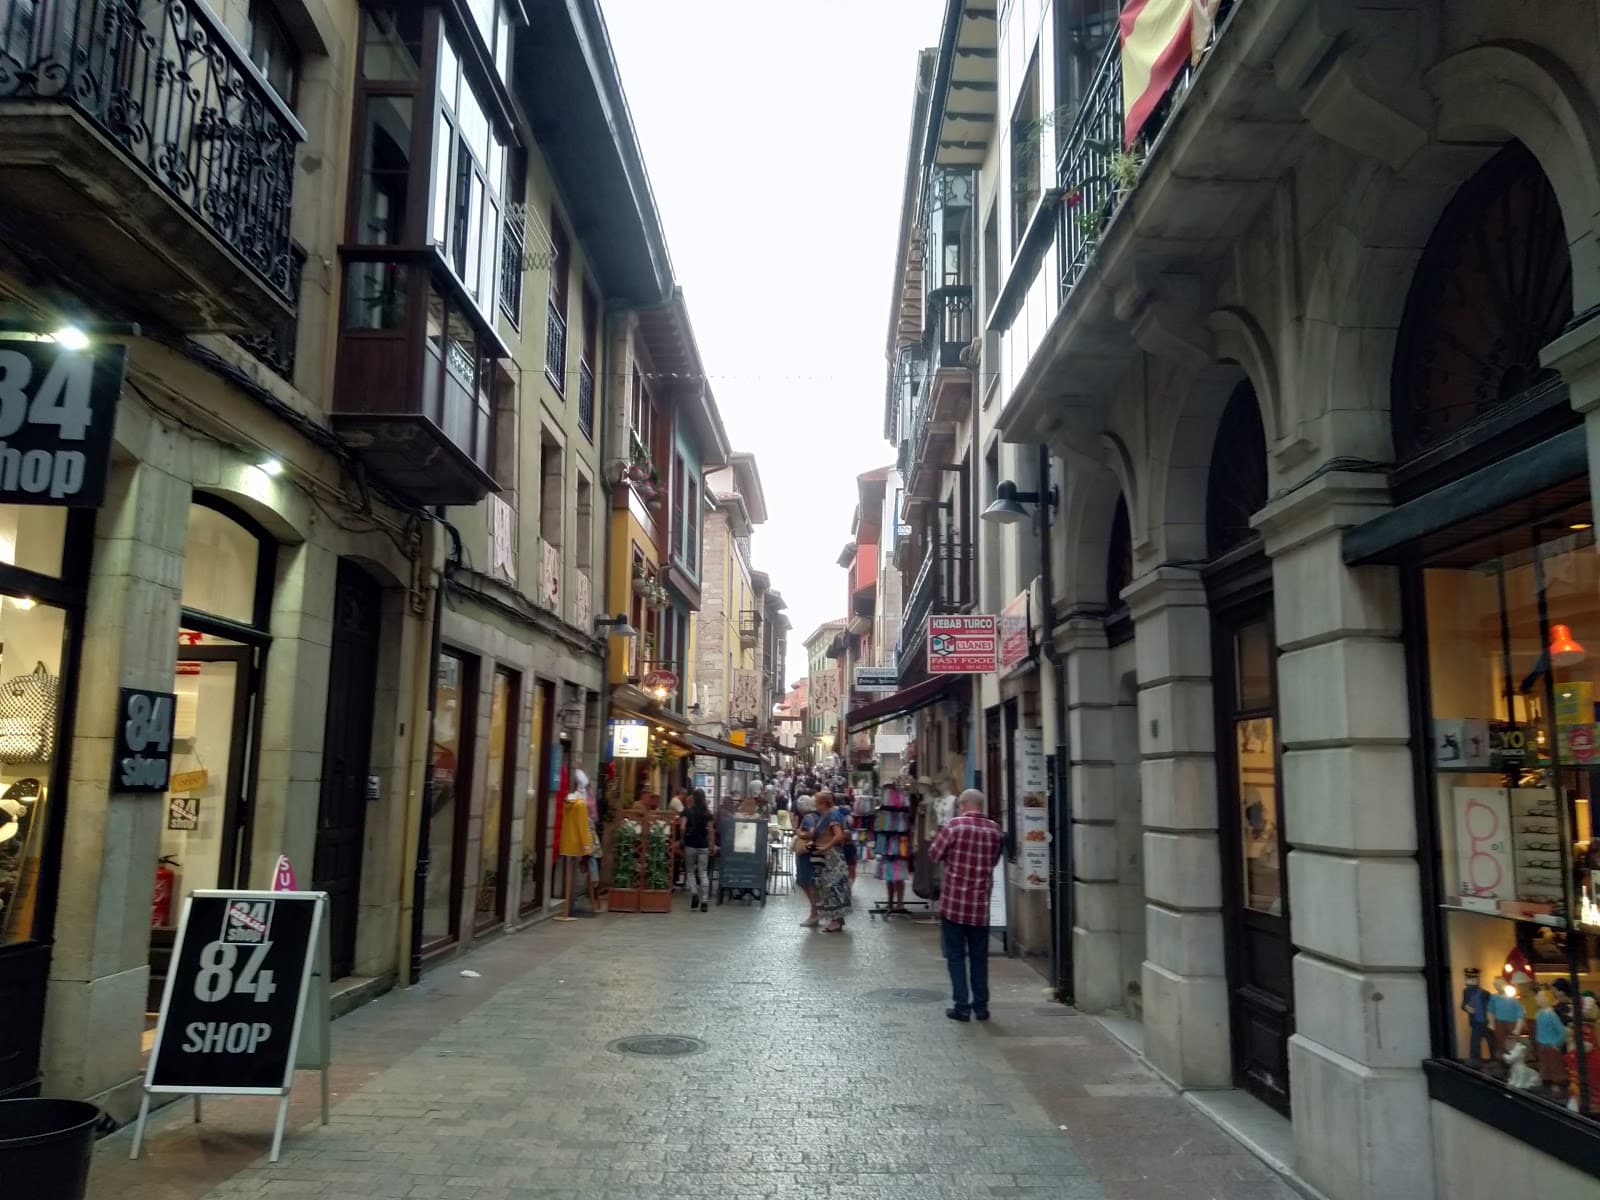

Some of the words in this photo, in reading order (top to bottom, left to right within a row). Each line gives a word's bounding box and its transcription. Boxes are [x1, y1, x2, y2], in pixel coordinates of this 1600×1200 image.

[932, 618, 962, 629] KEBAB
[964, 618, 993, 629] TURCO
[956, 641, 993, 650] LLANES
[125, 694, 172, 751] 84
[279, 857, 292, 892] SU
[230, 902, 267, 927] 84
[194, 940, 276, 1003] 84
[181, 1022, 272, 1053] SHOP
